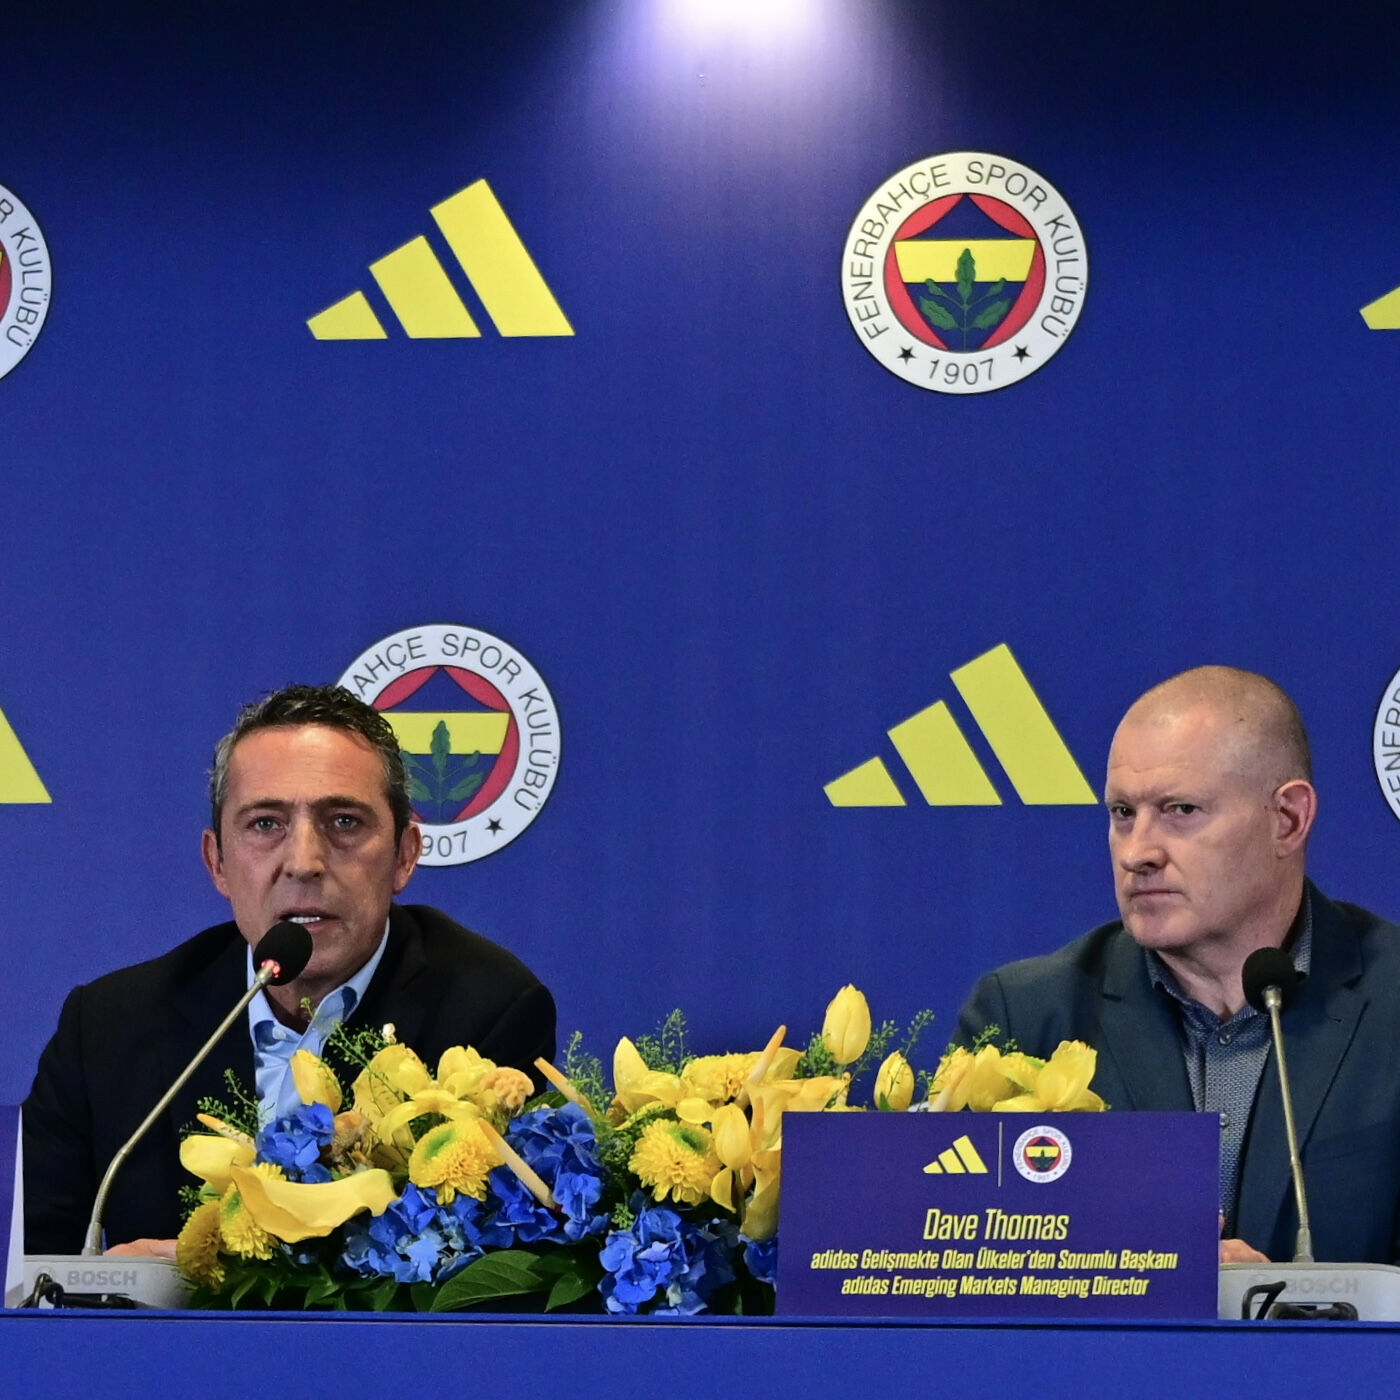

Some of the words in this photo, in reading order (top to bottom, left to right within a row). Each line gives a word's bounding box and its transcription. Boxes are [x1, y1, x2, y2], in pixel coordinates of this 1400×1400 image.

[850, 163, 950, 340] FENERBAHÇE
[965, 161, 1047, 212] SPOR
[1041, 214, 1084, 338] KULÜBÜ
[6, 227, 48, 347] KULÜBÜ
[929, 358, 994, 385] 1907
[352, 635, 427, 700] AHÇE
[441, 633, 522, 685] SPOR
[514, 688, 557, 811] KULÜBÜ
[420, 830, 468, 858] 907
[923, 1208, 979, 1240] Dave
[984, 1208, 1070, 1240] Thomas
[810, 1249, 859, 1269] adidas
[860, 1249, 940, 1272] Gelişmekte
[941, 1249, 975, 1269] Olan
[1057, 1249, 1118, 1270] Sorumlu
[1119, 1249, 1178, 1272] Başkanı
[67, 1270, 137, 1286] BOSCH
[841, 1276, 890, 1295] adidas
[891, 1276, 958, 1298] Emerging
[959, 1276, 1018, 1295] Markets
[1019, 1276, 1090, 1298] Managing
[1092, 1276, 1149, 1295] Director
